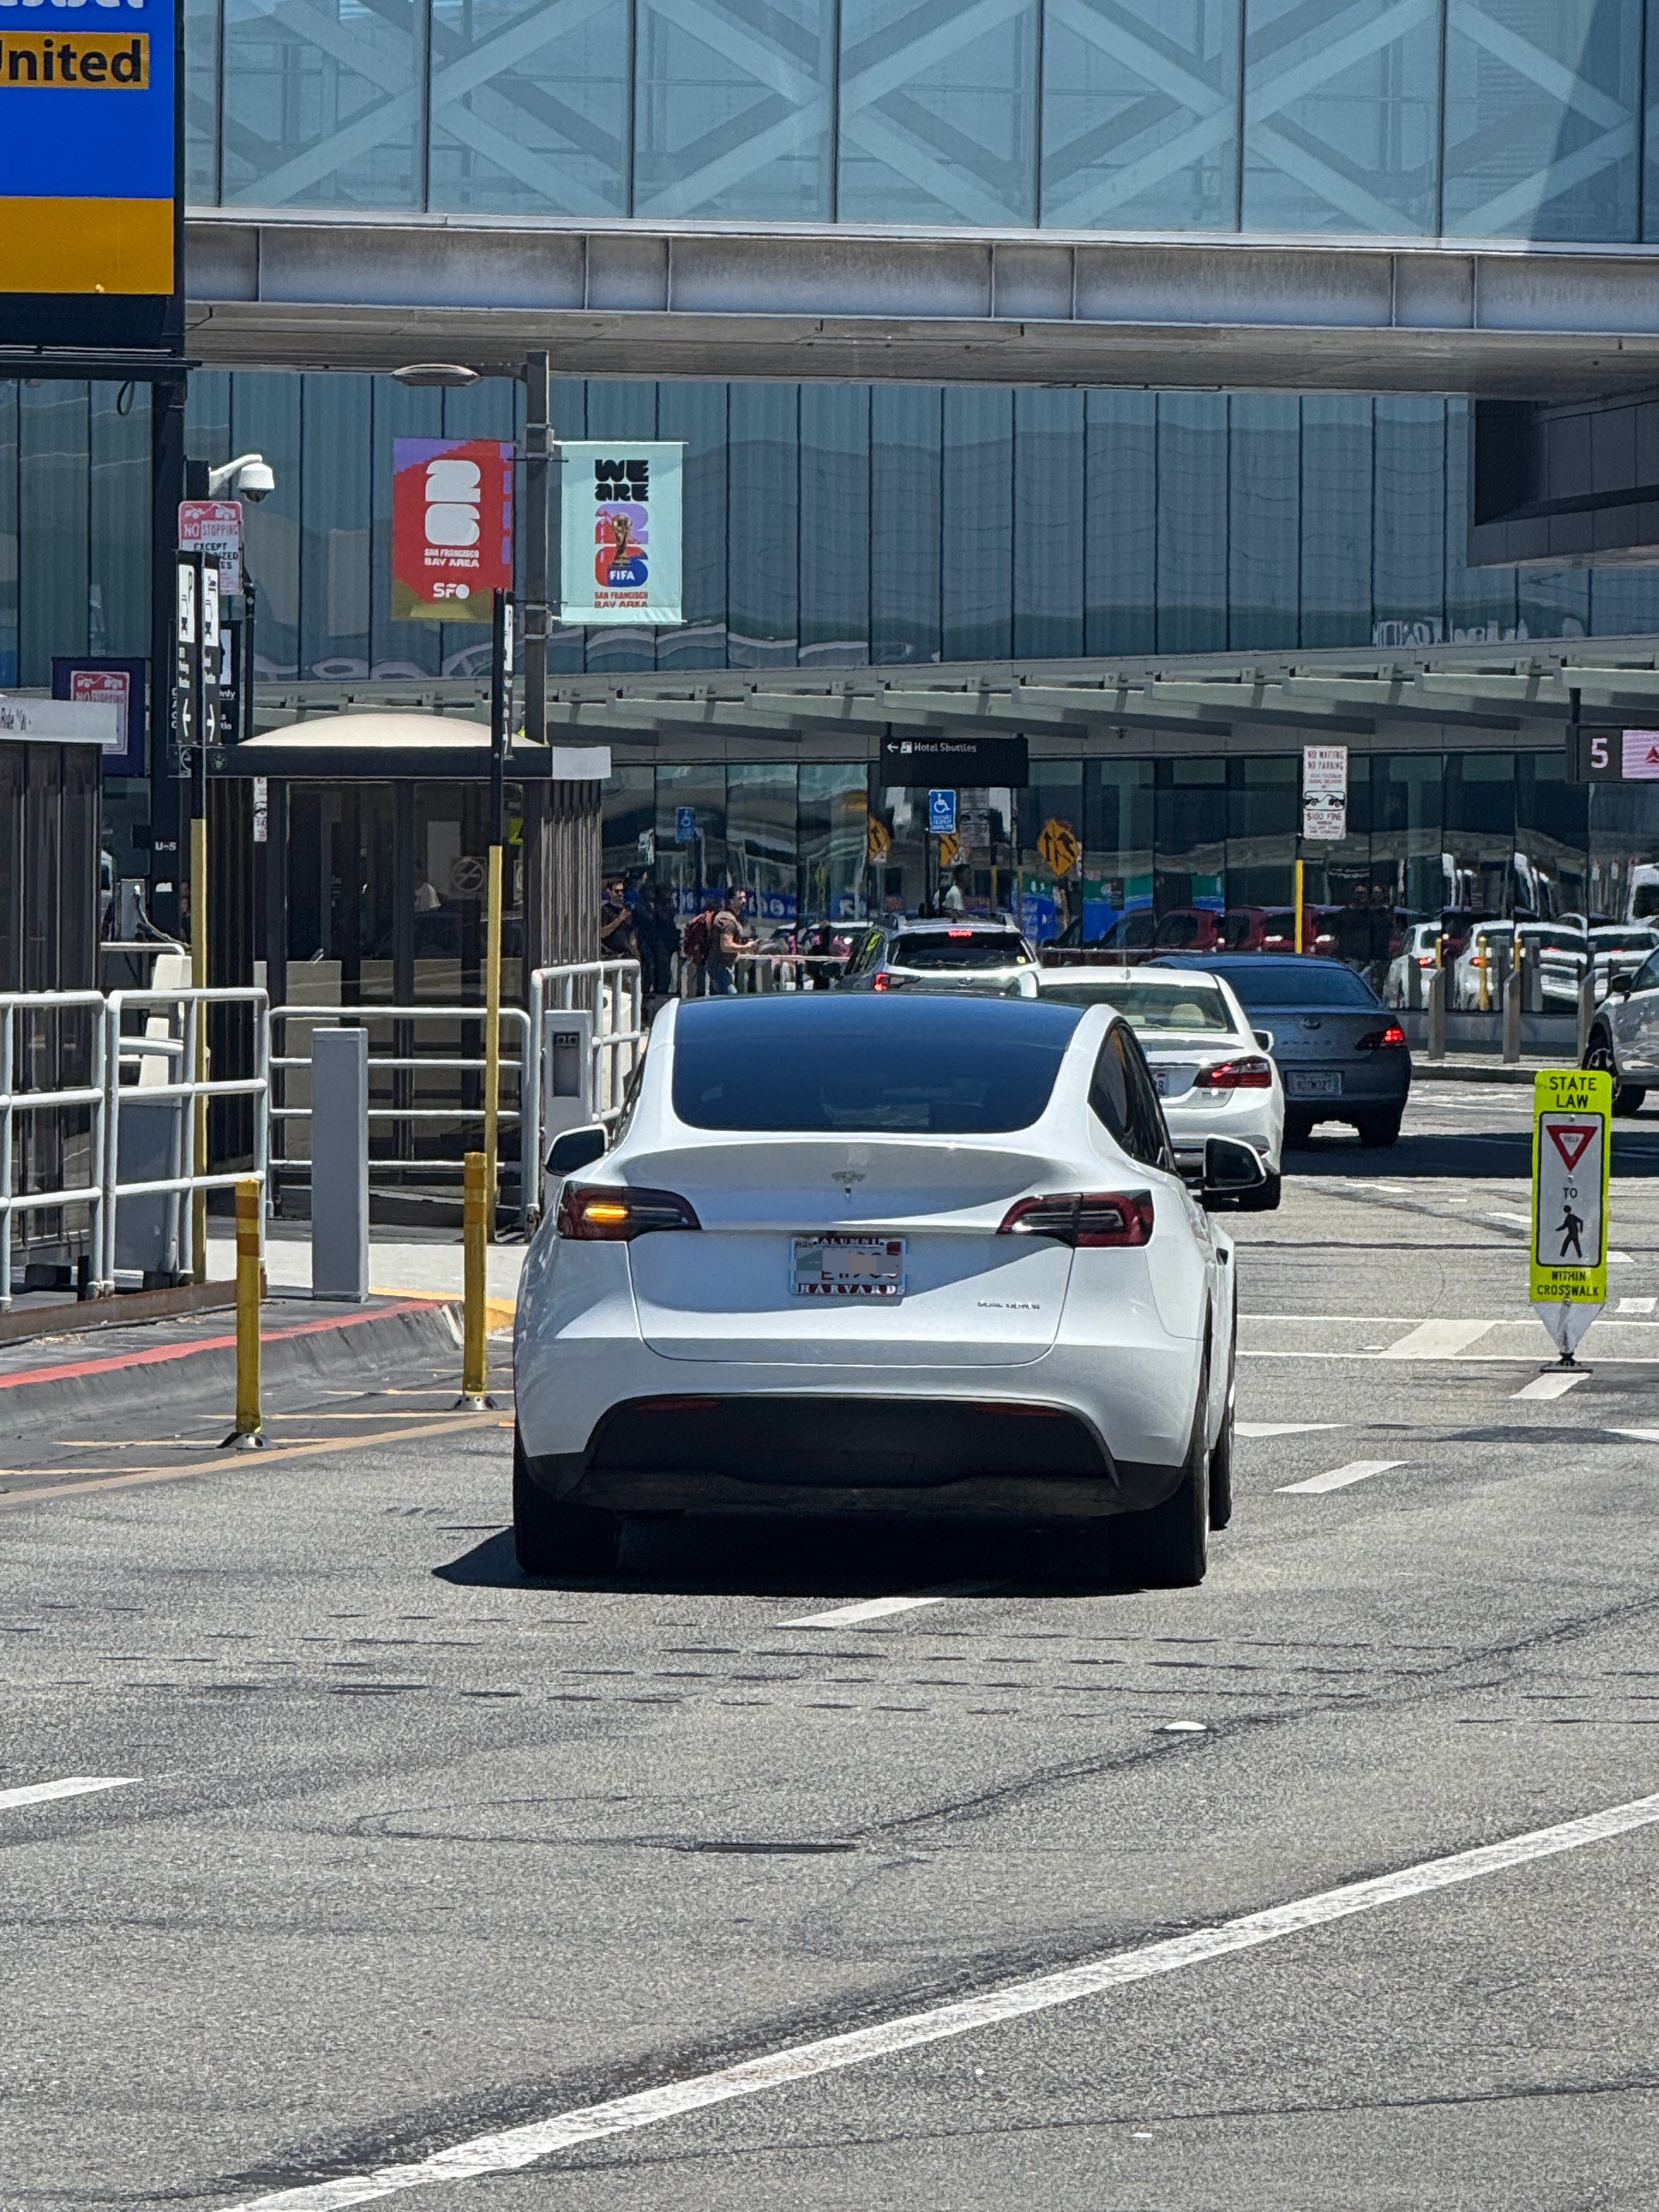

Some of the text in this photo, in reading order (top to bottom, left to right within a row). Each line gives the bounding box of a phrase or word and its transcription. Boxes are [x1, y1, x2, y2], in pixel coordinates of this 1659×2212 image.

[0, 39, 141, 82] nited
[595, 459, 649, 483] WE
[184, 522, 238, 537] NO STOPPING
[194, 543, 228, 551] EXCEPT
[424, 557, 480, 568] BAY AREA
[610, 570, 635, 580] FIFA
[433, 582, 470, 599] SFO
[915, 742, 938, 752] Hotel
[1591, 737, 1609, 769] 5
[1307, 761, 1344, 770] NO PARKING
[1549, 1076, 1597, 1091] STATE
[1556, 1094, 1589, 1109] LAW
[1564, 1188, 1578, 1199] TO
[1551, 1271, 1586, 1282] WITHIN
[800, 1284, 896, 1295] HARVARD
[1537, 1284, 1599, 1296] CROSSWALK
